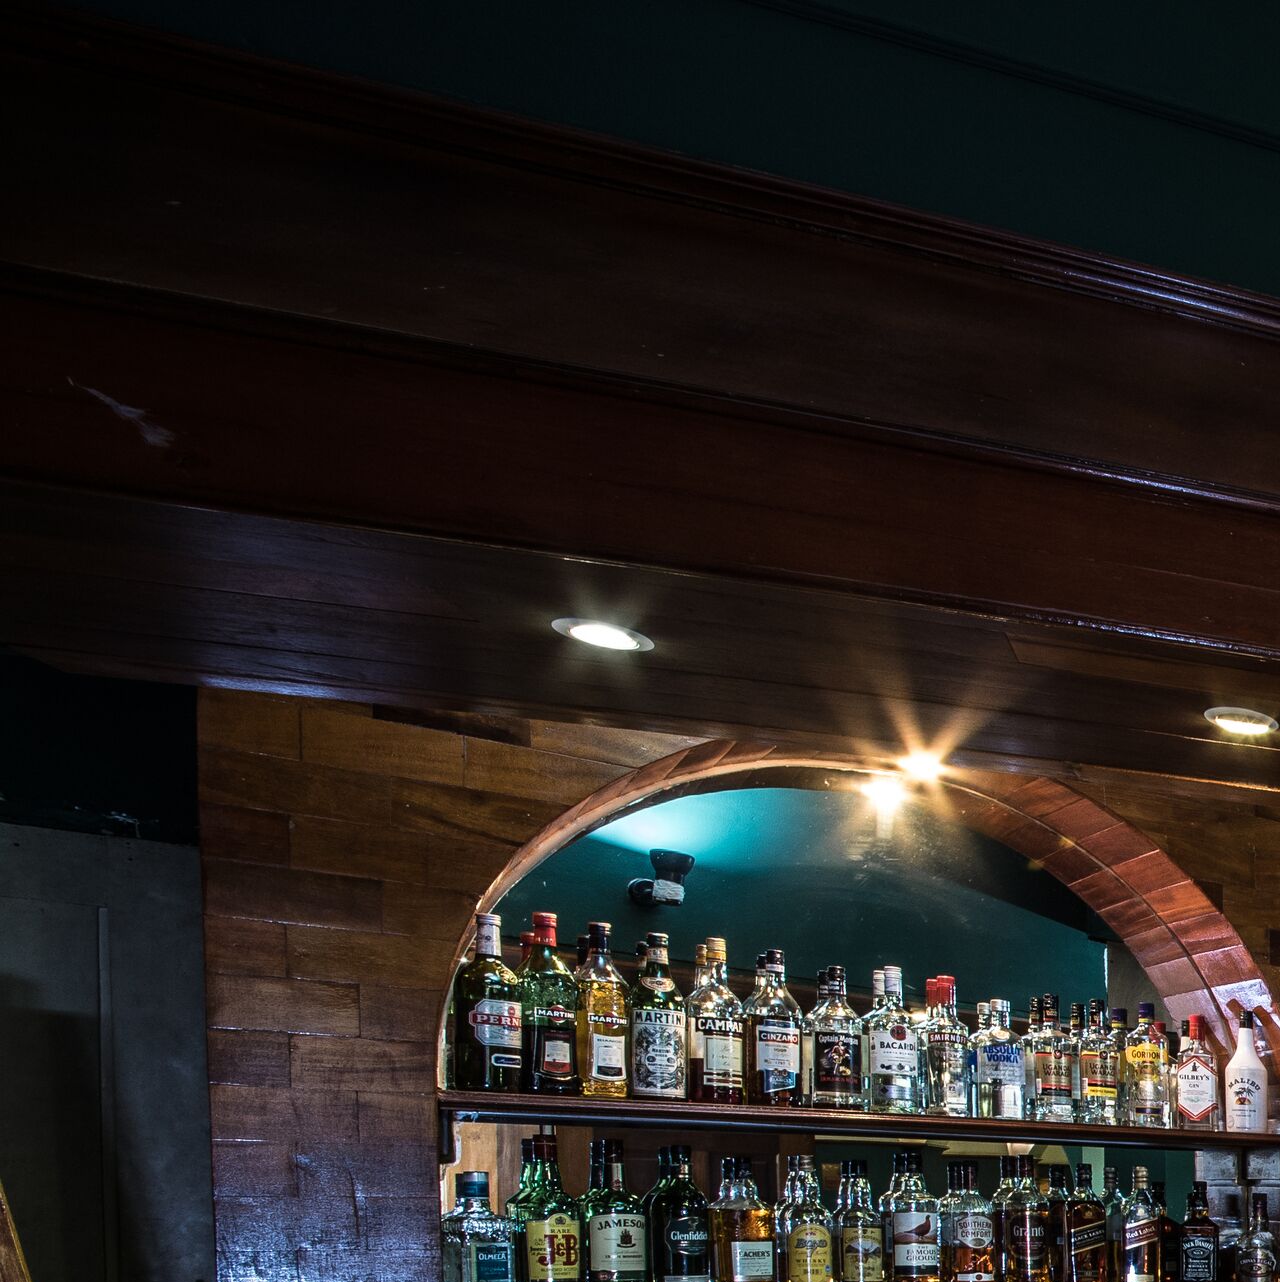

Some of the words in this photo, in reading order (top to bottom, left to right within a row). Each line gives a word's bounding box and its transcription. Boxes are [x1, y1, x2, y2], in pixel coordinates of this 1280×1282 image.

[538, 1009, 575, 1019] MARTINI
[635, 1012, 685, 1026] MARTINI
[476, 1013, 521, 1027] PERN
[591, 1016, 627, 1025] MARTINI
[698, 1019, 743, 1033] CAMPAR
[761, 1033, 798, 1043] CINZANO
[930, 1034, 967, 1044] SMIRNOFF
[983, 1045, 1020, 1056] ABSOLUT
[1131, 1050, 1161, 1060] GORDON
[986, 1053, 1019, 1063] VODKA
[1228, 1077, 1261, 1091] MALIBU
[959, 1222, 992, 1230] SOUTHERN
[961, 1230, 991, 1238] COMFORT
[1073, 1233, 1088, 1242] LACK
[1126, 1231, 1138, 1239] Red
[1139, 1226, 1156, 1235] Label
[478, 1253, 508, 1261] OLMECA
